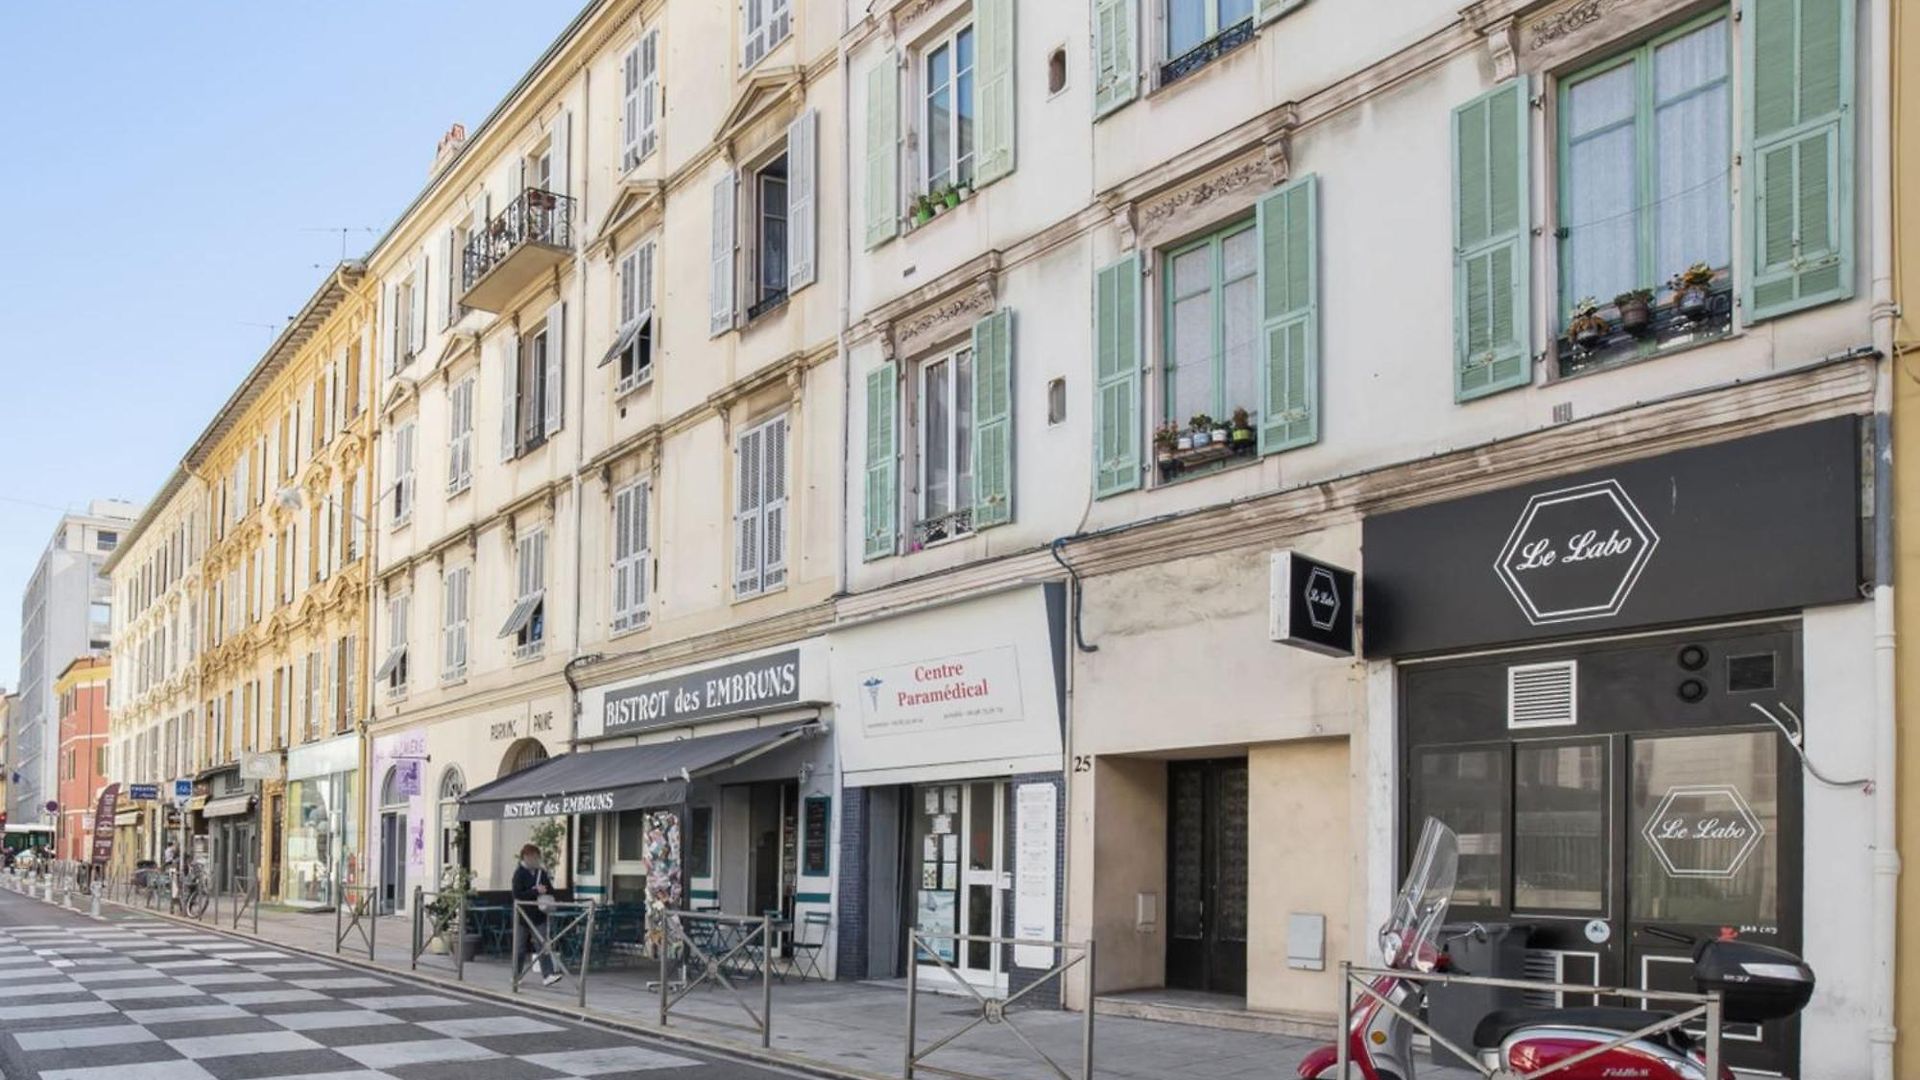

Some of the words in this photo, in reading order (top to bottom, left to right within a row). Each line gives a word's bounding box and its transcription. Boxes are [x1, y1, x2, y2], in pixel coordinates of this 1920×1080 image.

[1516, 538, 1556, 571] Le
[1562, 529, 1632, 563] Labo
[914, 663, 964, 683] Centre
[606, 690, 669, 727] BISTROT
[674, 687, 700, 714] des
[706, 663, 796, 708] EMBRUNS
[897, 678, 989, 708] Paramédical
[1074, 755, 1091, 772] 25
[503, 801, 543, 818] BISTROT
[543, 799, 560, 814] des
[562, 792, 615, 813] EMBRUNS
[1657, 818, 1688, 839] Le
[1692, 818, 1746, 839] Labo
